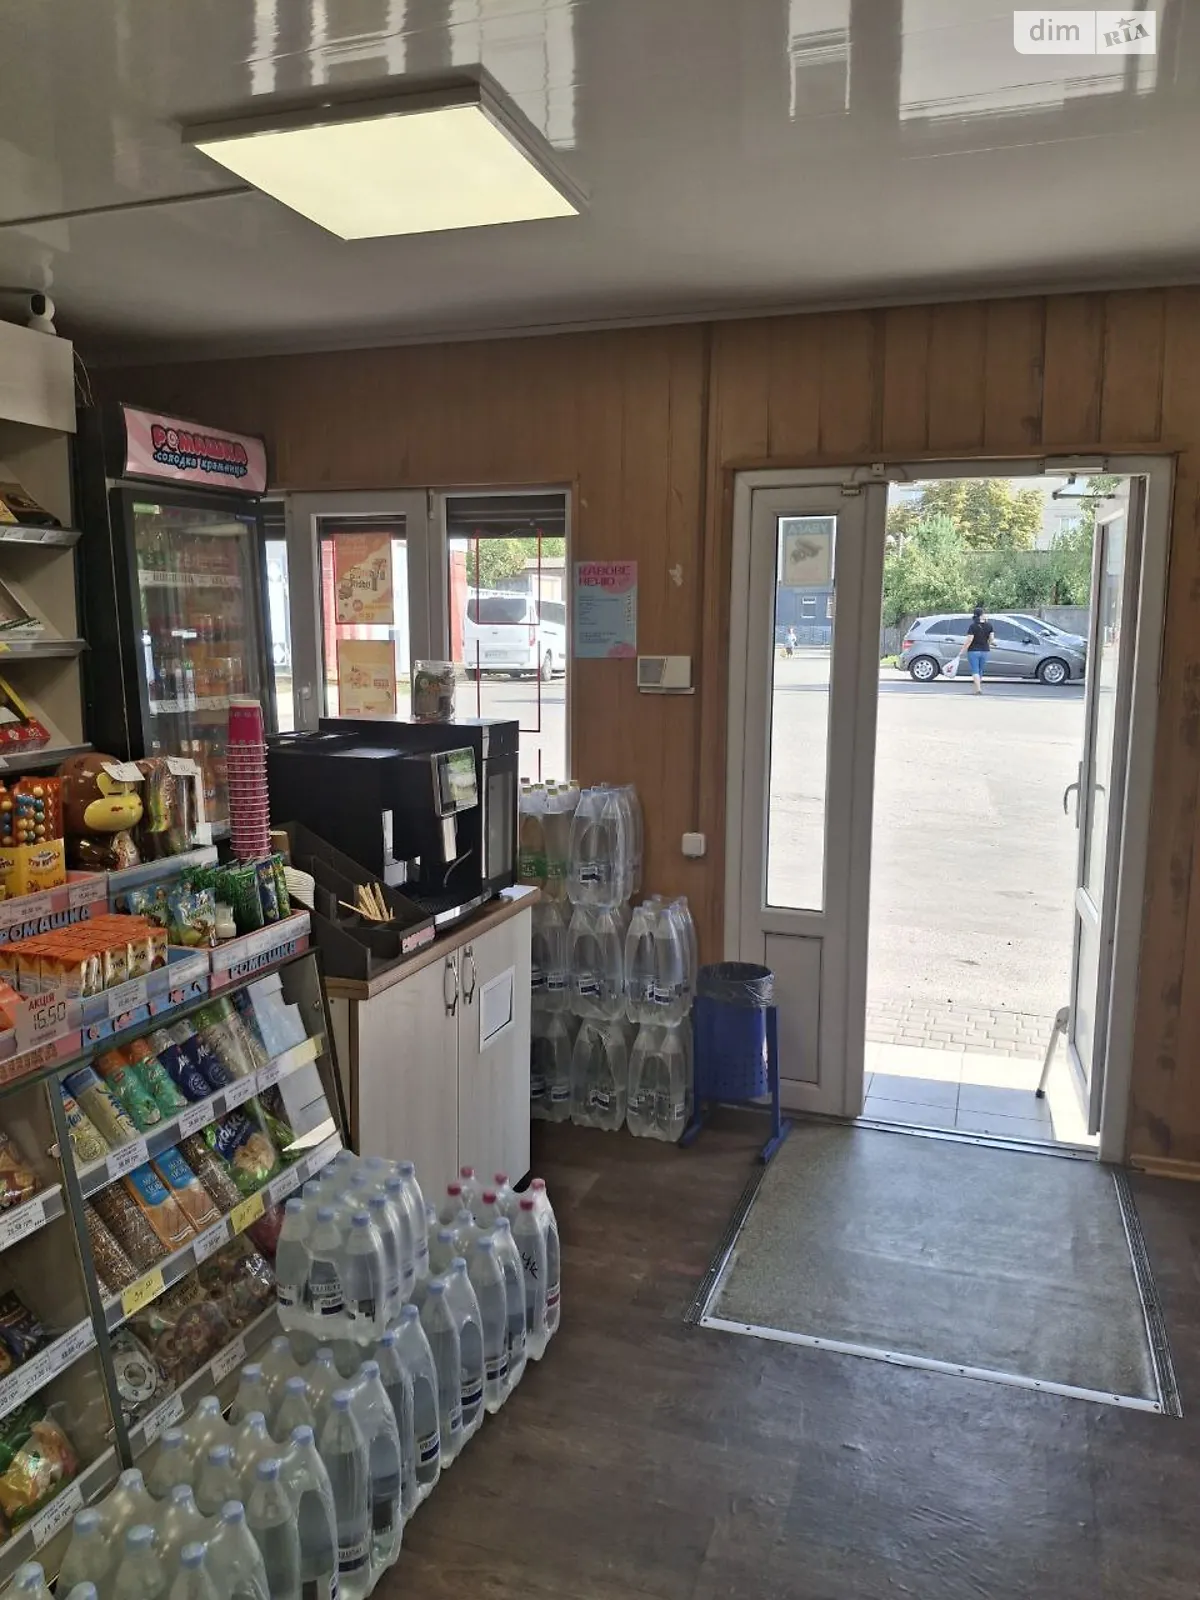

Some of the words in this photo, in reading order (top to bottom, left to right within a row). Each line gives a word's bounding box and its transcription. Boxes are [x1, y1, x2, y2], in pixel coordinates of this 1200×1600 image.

[151, 424, 249, 466] РОМАШКА
[228, 939, 297, 979] РОМАШКА
[28, 993, 56, 1011] АКЦІЯ
